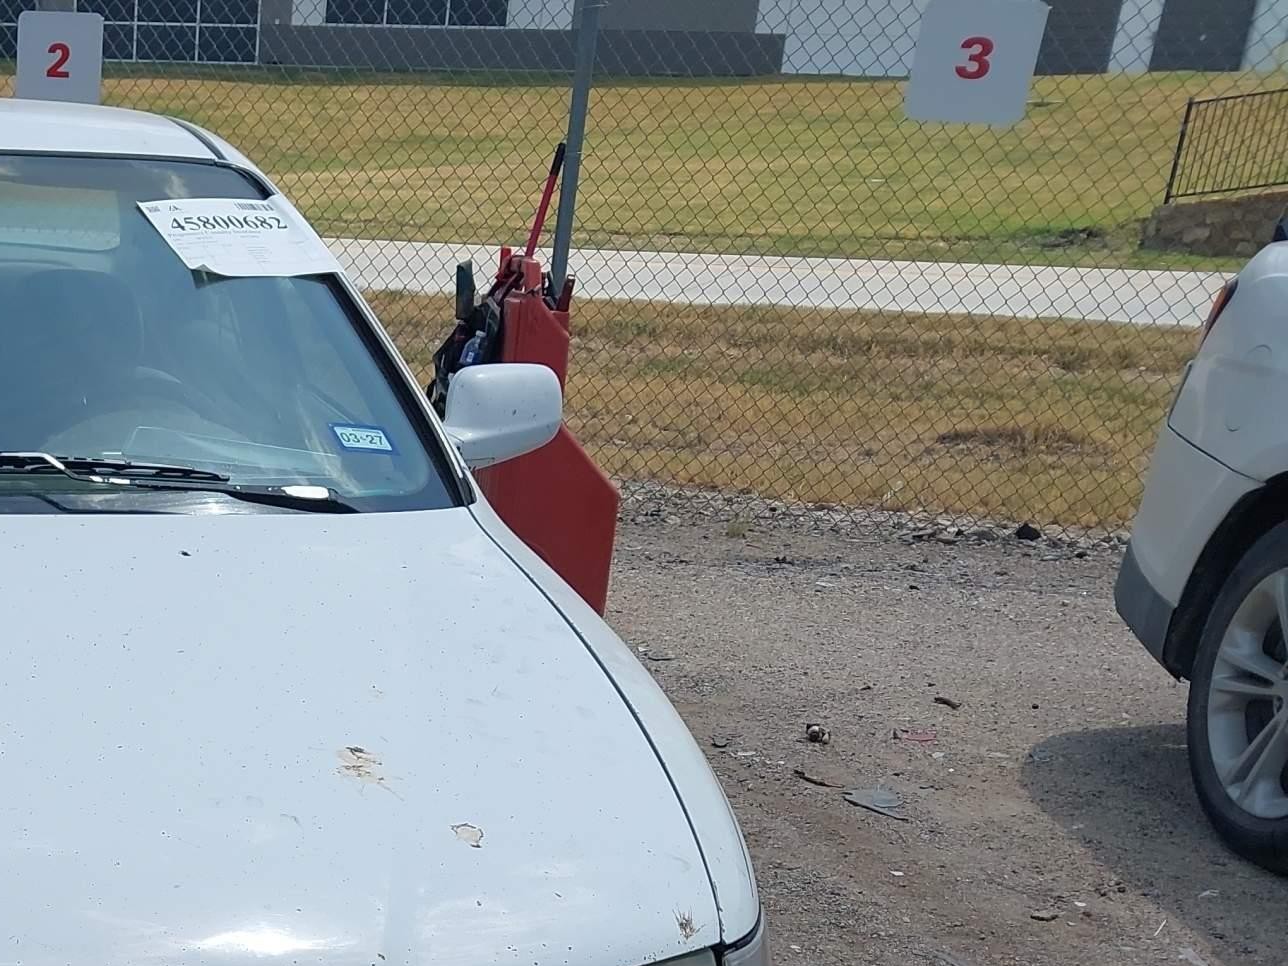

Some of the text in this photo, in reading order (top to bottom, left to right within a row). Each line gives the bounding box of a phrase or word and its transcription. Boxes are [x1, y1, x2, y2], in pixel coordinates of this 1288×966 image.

[46, 42, 70, 78] 2
[955, 37, 994, 79] 3
[171, 215, 288, 231] 45800682
